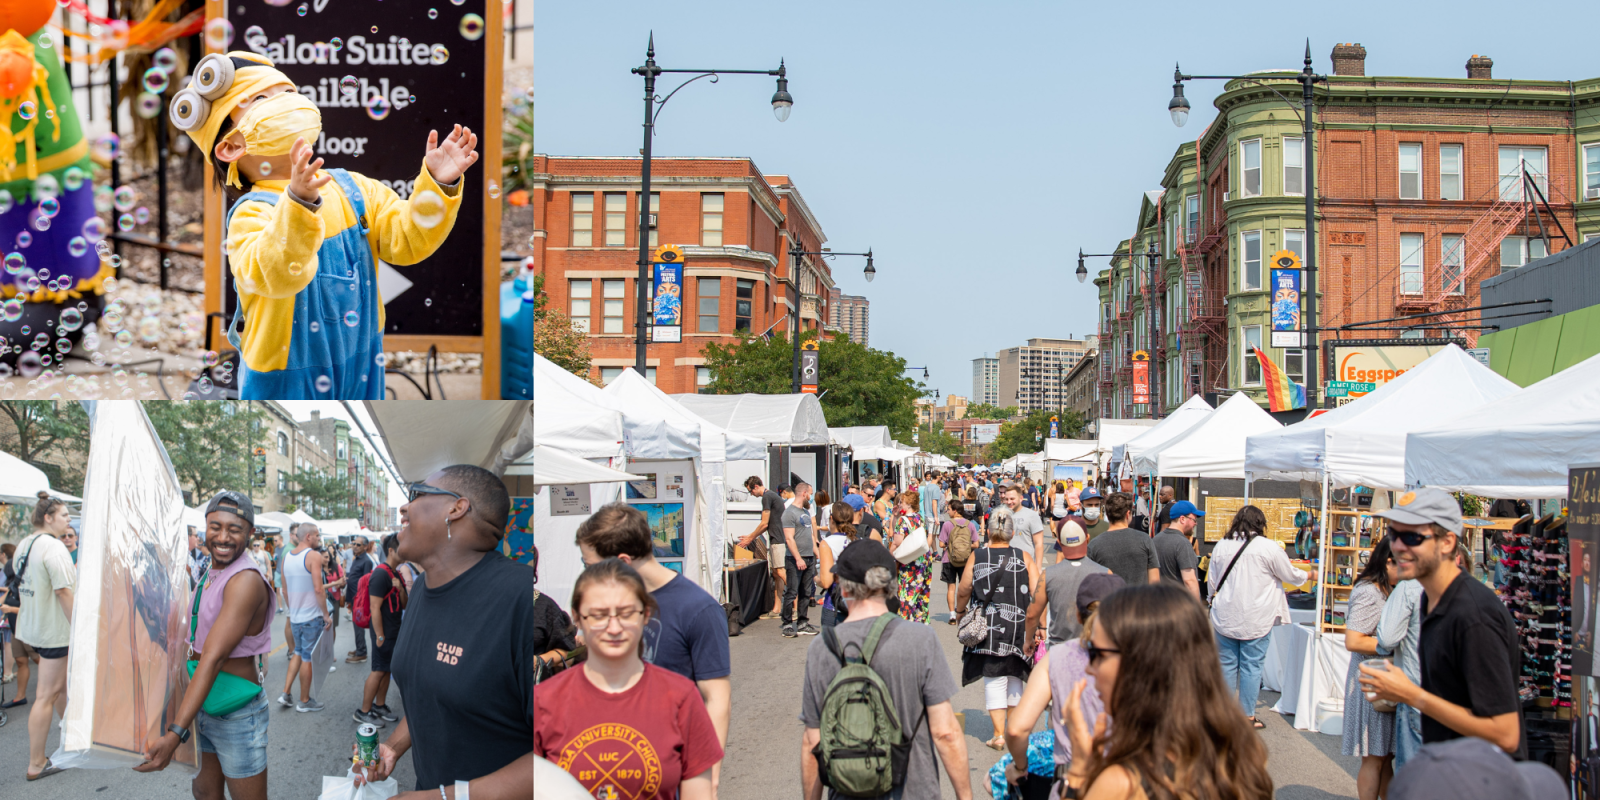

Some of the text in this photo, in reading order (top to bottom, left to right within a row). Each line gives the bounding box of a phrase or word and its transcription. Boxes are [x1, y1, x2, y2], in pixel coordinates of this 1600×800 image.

[249, 34, 447, 65] Salon Suites
[298, 78, 410, 108] ailable
[313, 131, 368, 155] loor
[1347, 366, 1407, 383] Eggspe
[437, 642, 463, 656] CLUB
[436, 652, 458, 665] BAD
[559, 725, 660, 793] OLA UNIVERSITY CHICAGO
[599, 751, 620, 762] LUC
[579, 769, 642, 781] EST 1870
